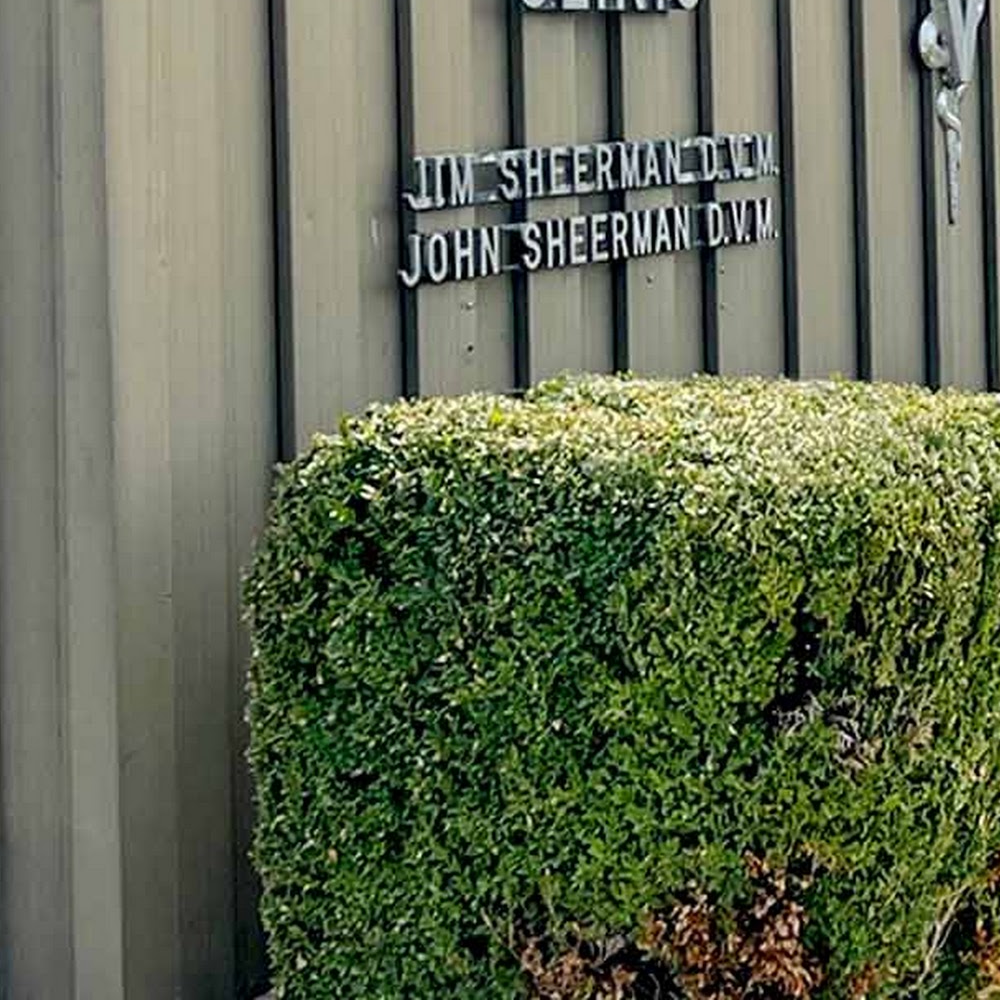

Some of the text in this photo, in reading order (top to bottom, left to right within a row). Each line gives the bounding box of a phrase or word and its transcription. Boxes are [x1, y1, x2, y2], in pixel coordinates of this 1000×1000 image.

[402, 155, 475, 211] JIM
[500, 138, 682, 200] SHEERMAN
[399, 198, 779, 288] JOHN SHEERMAN D.V.M.
